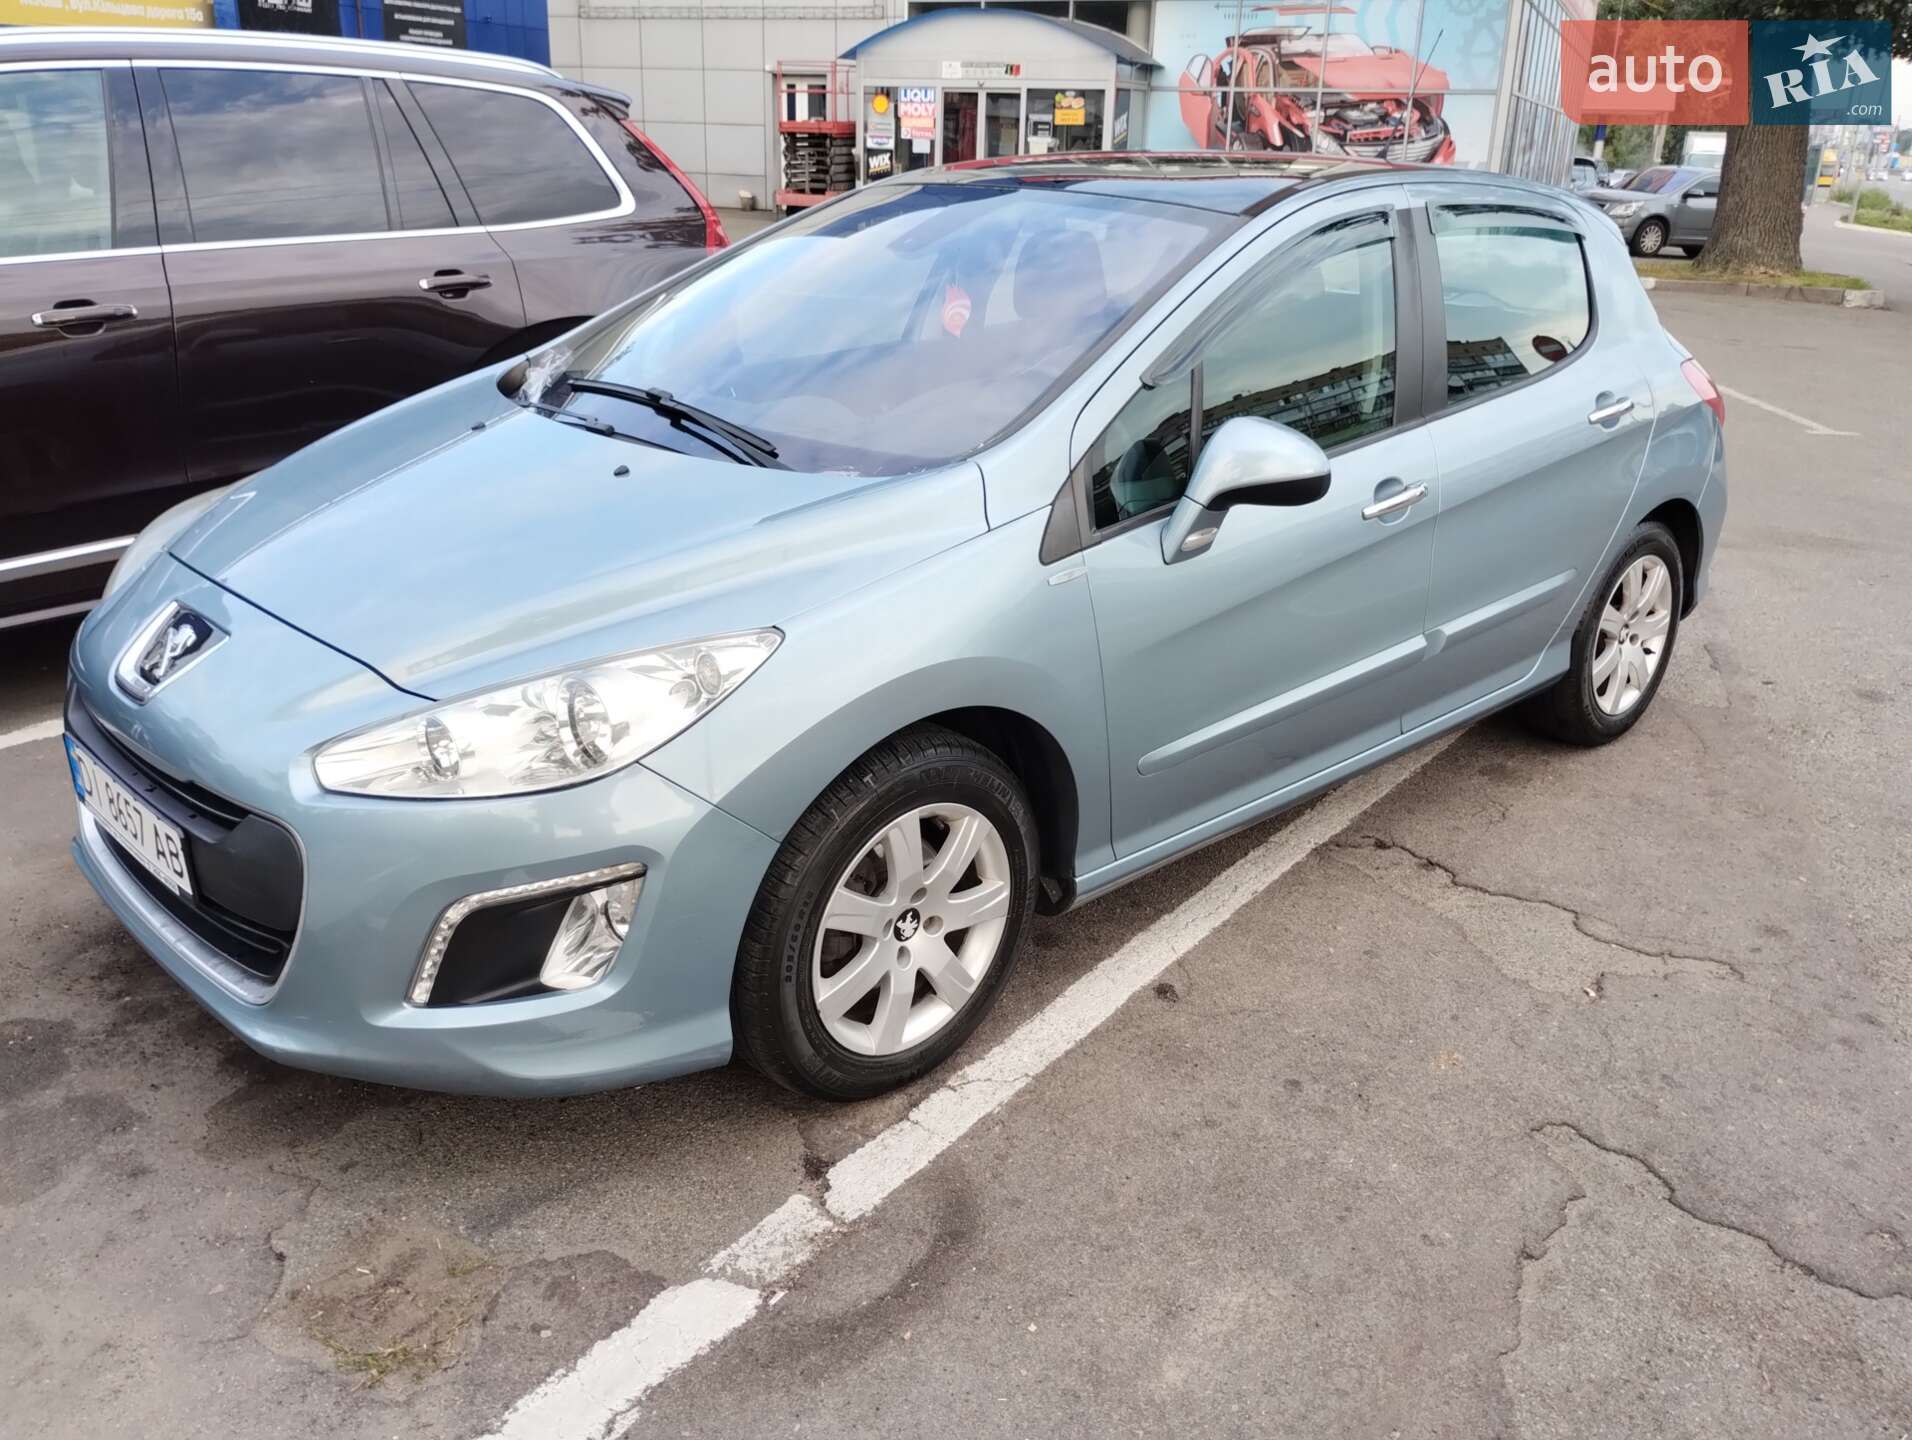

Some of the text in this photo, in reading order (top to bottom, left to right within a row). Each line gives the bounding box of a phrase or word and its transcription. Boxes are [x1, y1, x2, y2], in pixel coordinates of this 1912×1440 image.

[901, 87, 935, 102] LIQUI
[901, 103, 935, 117] MOLY
[868, 152, 891, 169] WIX
[77, 755, 104, 807] DI
[105, 782, 145, 848] 8657
[153, 823, 184, 879] AB
